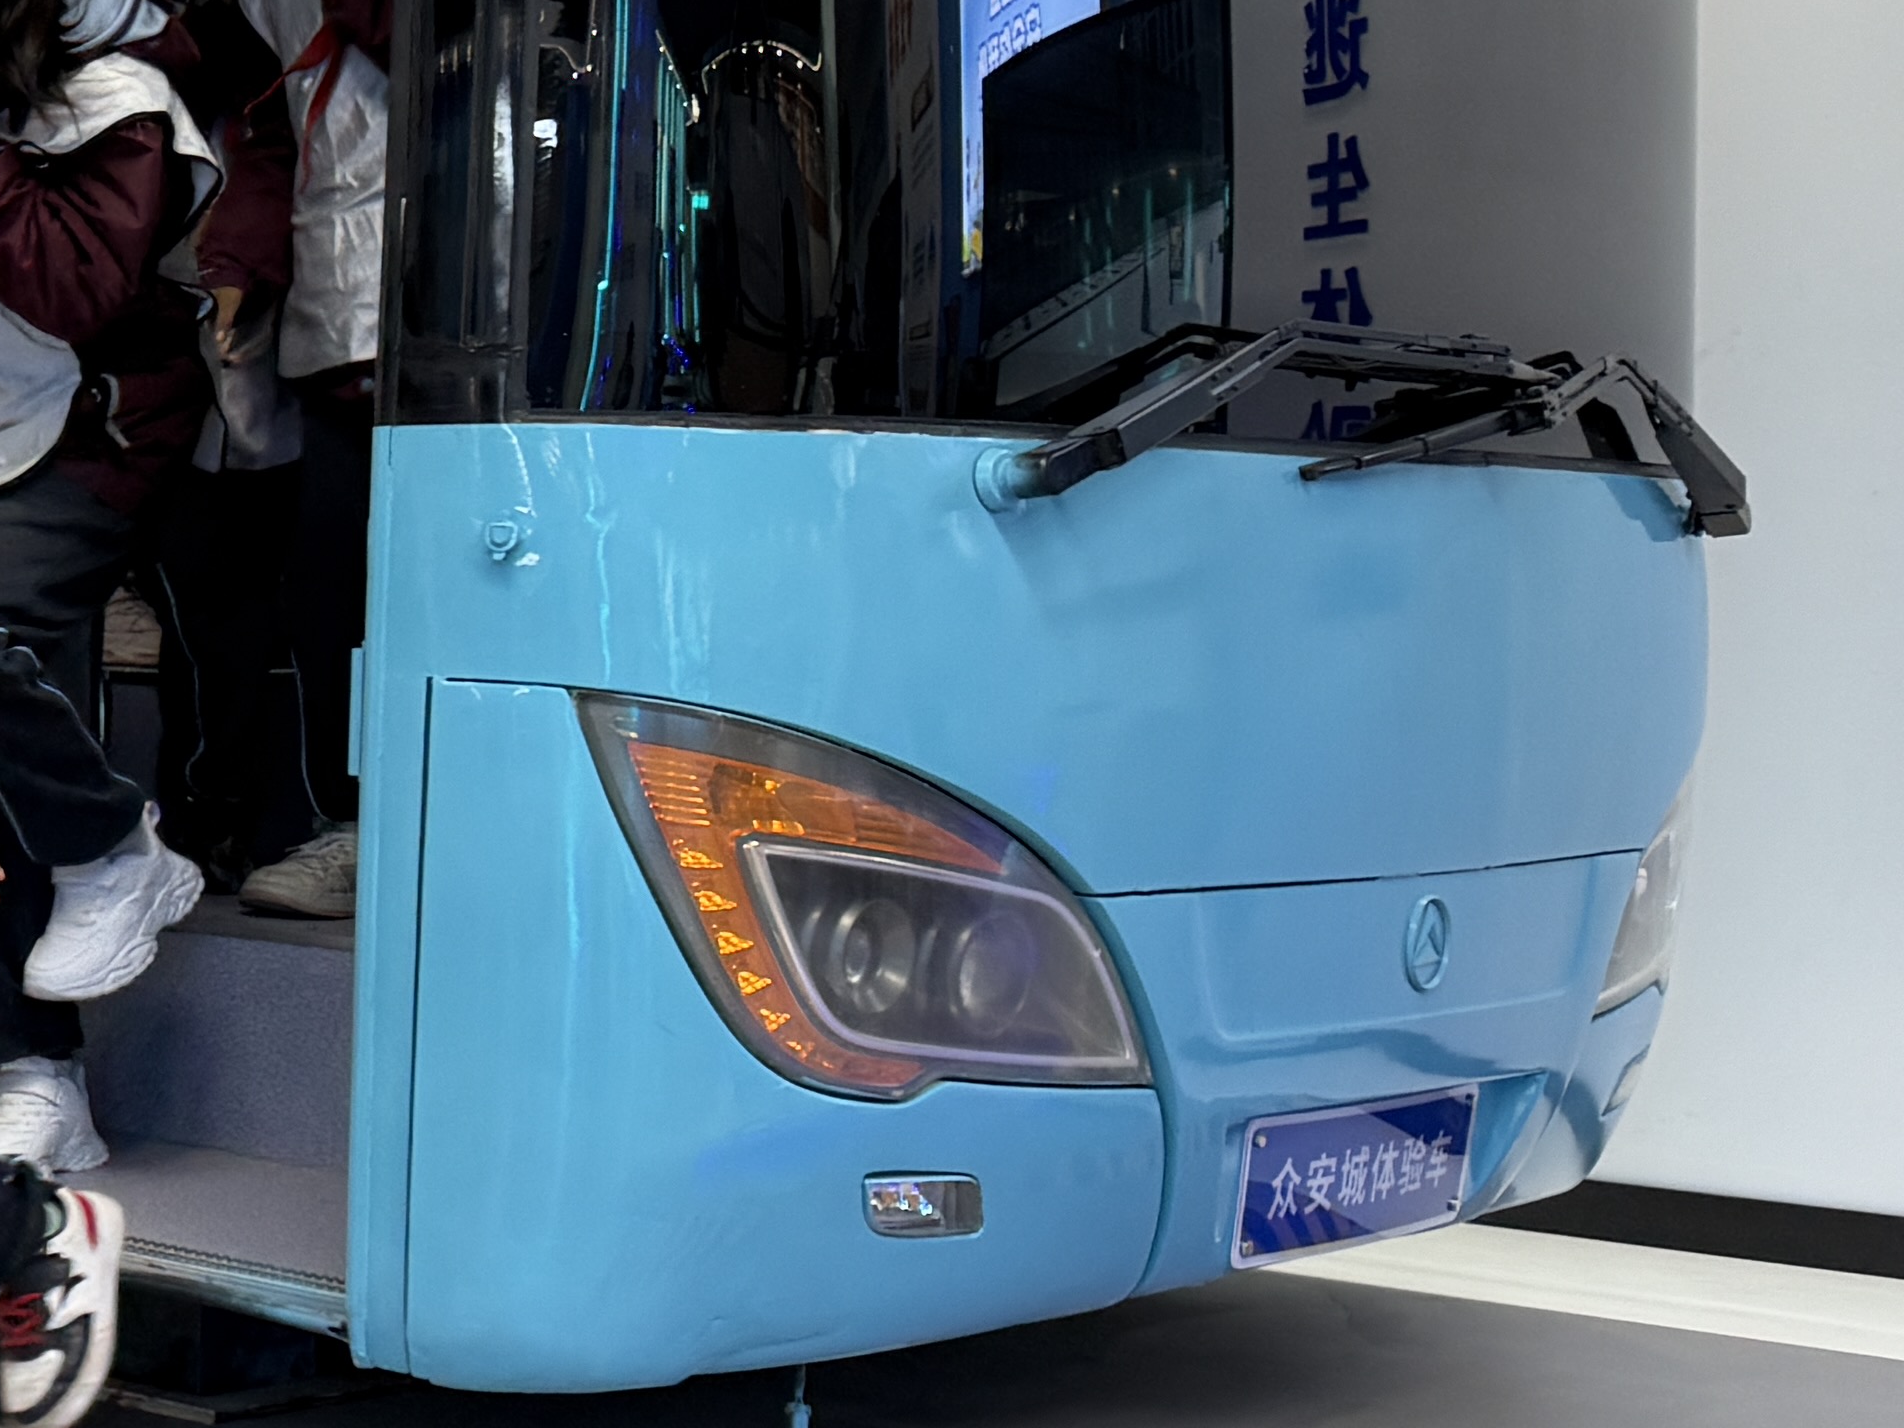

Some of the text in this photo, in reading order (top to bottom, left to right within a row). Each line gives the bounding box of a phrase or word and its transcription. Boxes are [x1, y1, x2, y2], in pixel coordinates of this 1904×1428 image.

[1266, 1130, 1453, 1221] 众安城体验车
